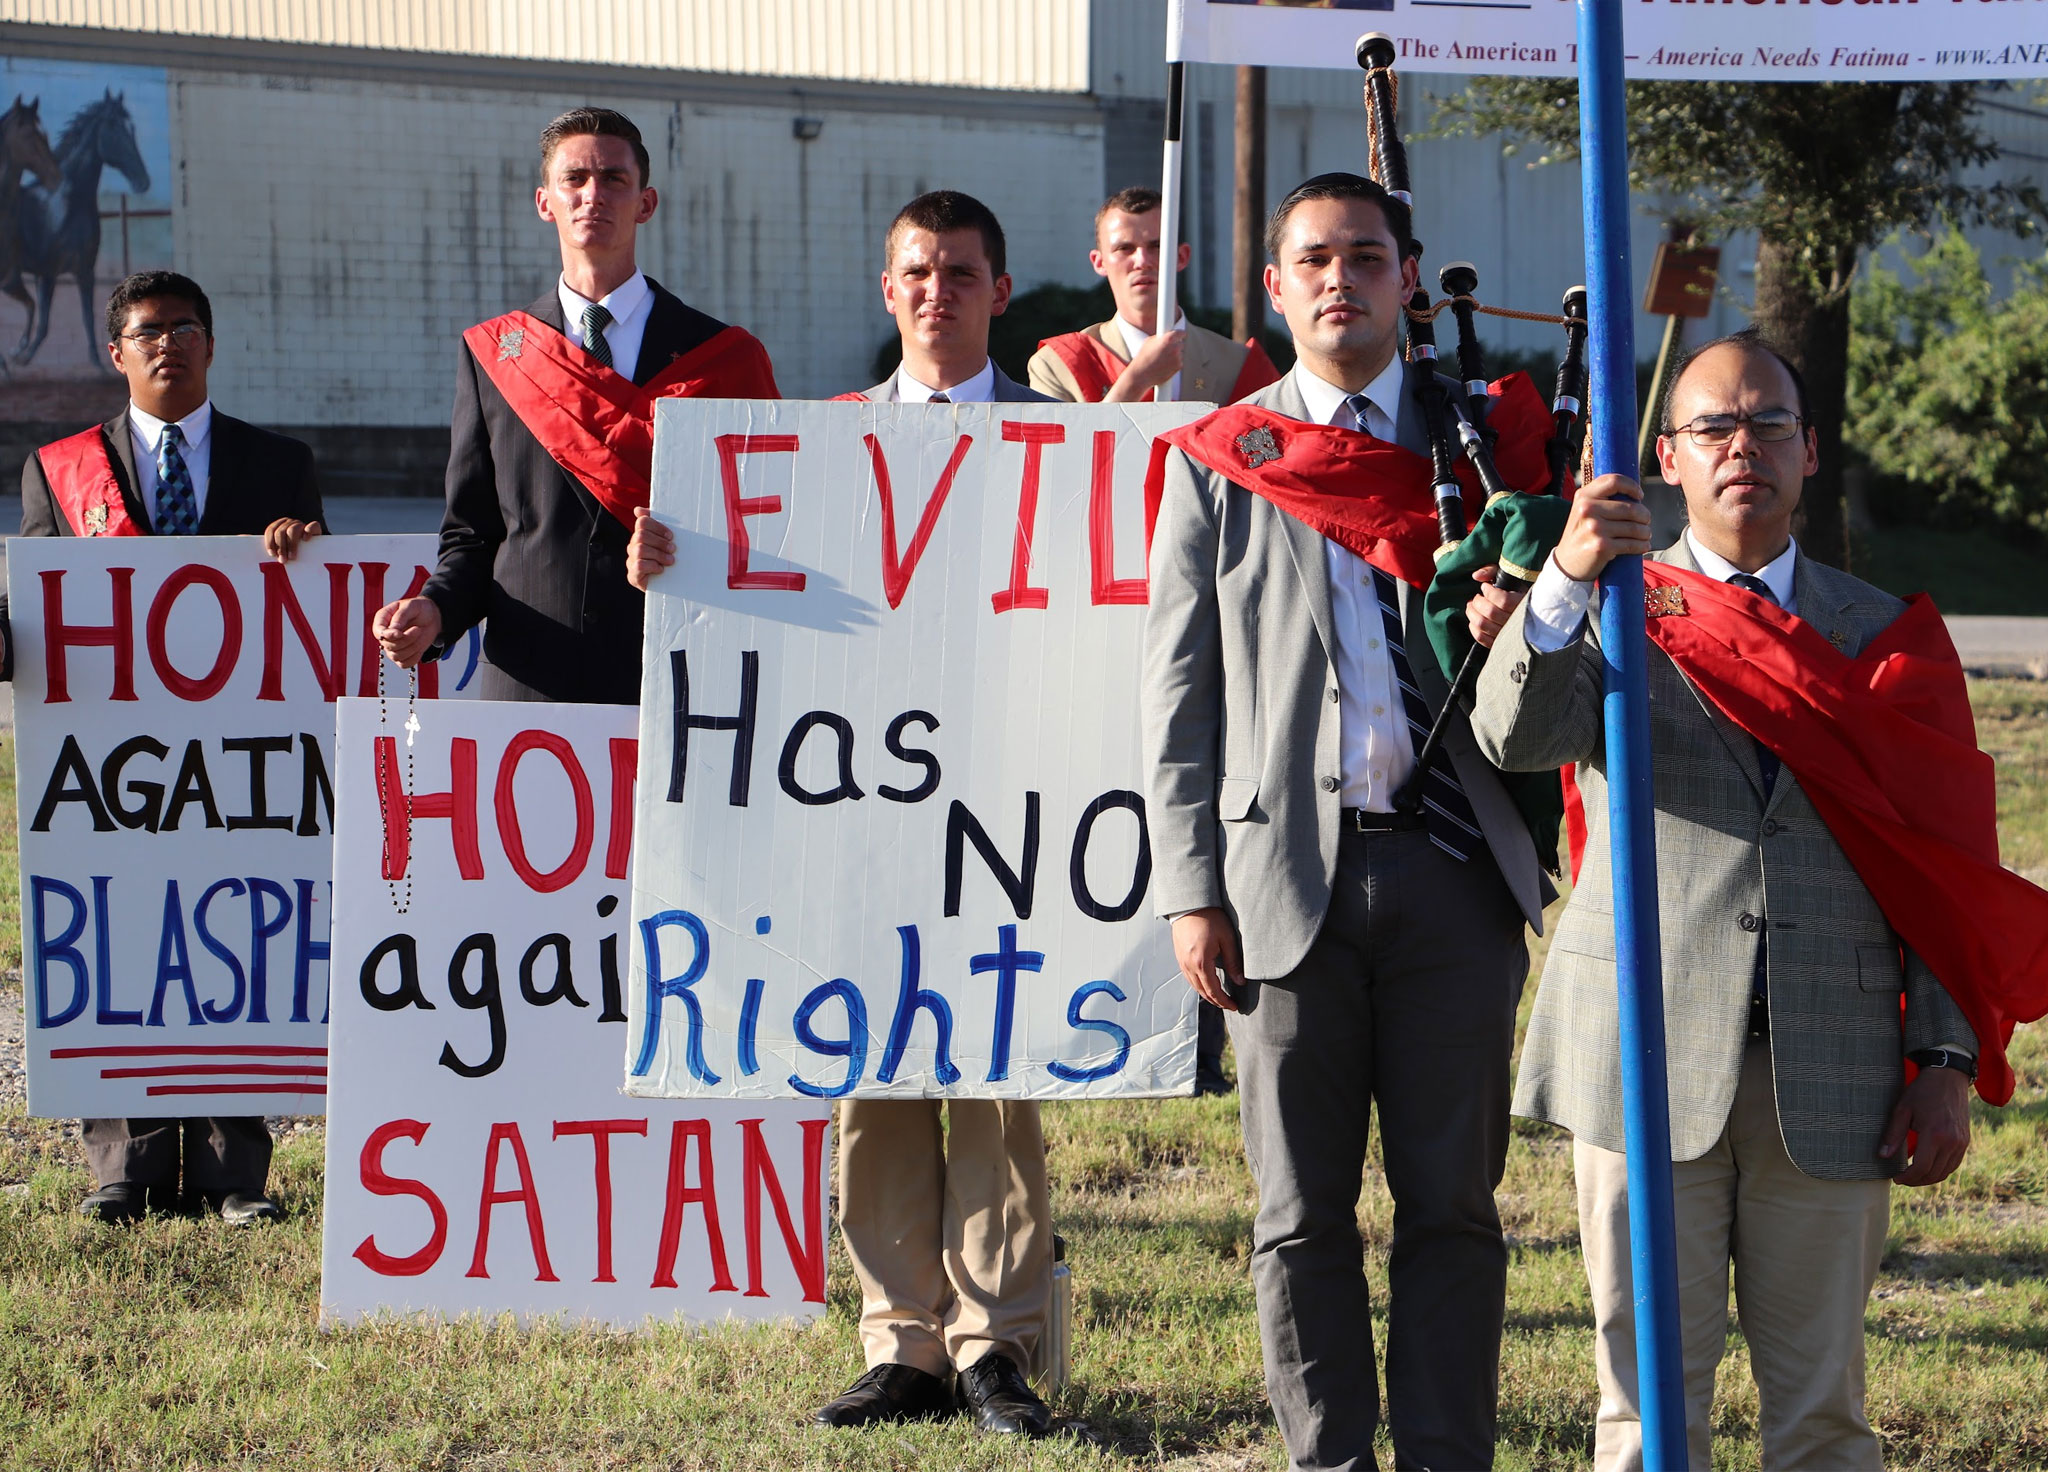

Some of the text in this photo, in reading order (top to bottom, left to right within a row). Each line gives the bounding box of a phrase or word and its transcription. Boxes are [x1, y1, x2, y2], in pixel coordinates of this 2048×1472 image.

[1397, 37, 1439, 58] The
[1446, 40, 1557, 62] American
[1647, 46, 1744, 66] America
[1752, 47, 1821, 66] Needs
[1829, 47, 1909, 66] Fatima
[714, 420, 1149, 614] EVIL
[666, 650, 941, 807] Has
[944, 790, 1150, 922] NO
[631, 909, 1130, 1098] Rights
[352, 1118, 830, 1303] SATAN
